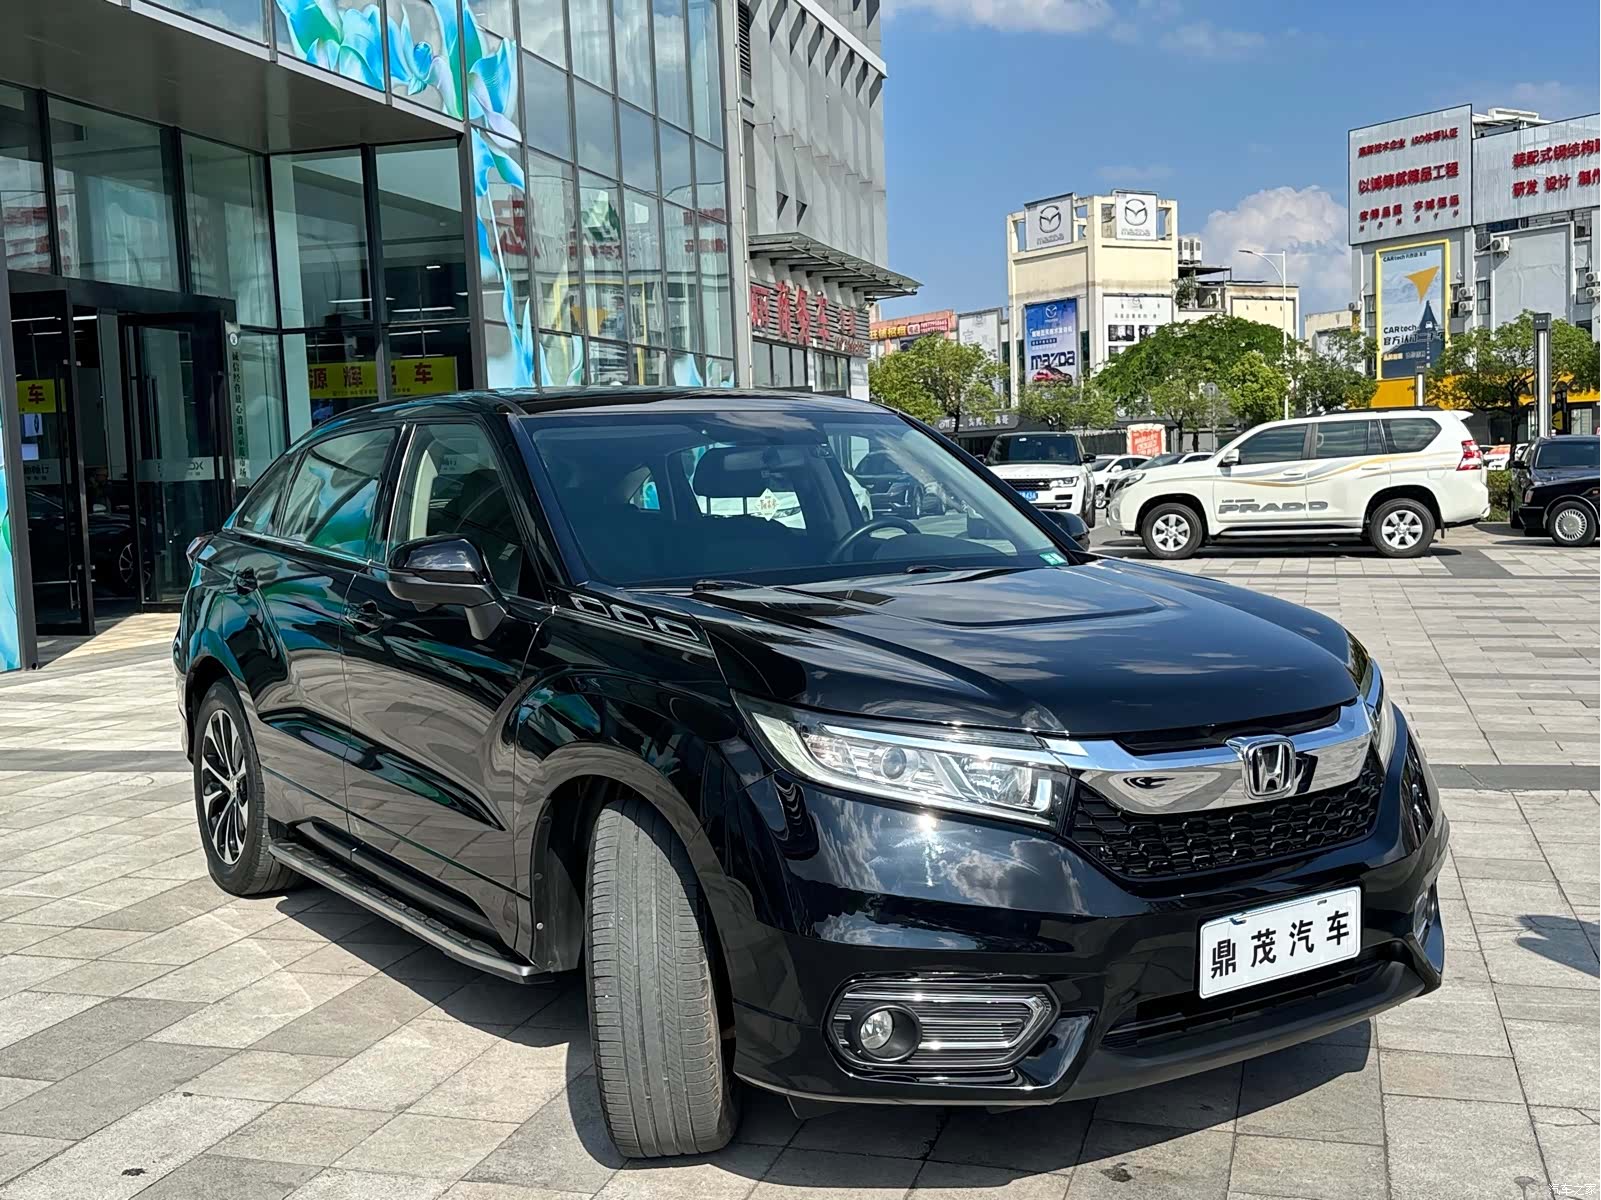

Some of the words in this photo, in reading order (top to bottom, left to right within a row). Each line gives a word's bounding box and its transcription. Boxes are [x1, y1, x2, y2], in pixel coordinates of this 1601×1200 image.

[1512, 180, 1538, 198] 研发
[1545, 174, 1571, 192] 设计
[1030, 350, 1075, 370] mazda
[1211, 910, 1350, 979] 鼎茂汽车
